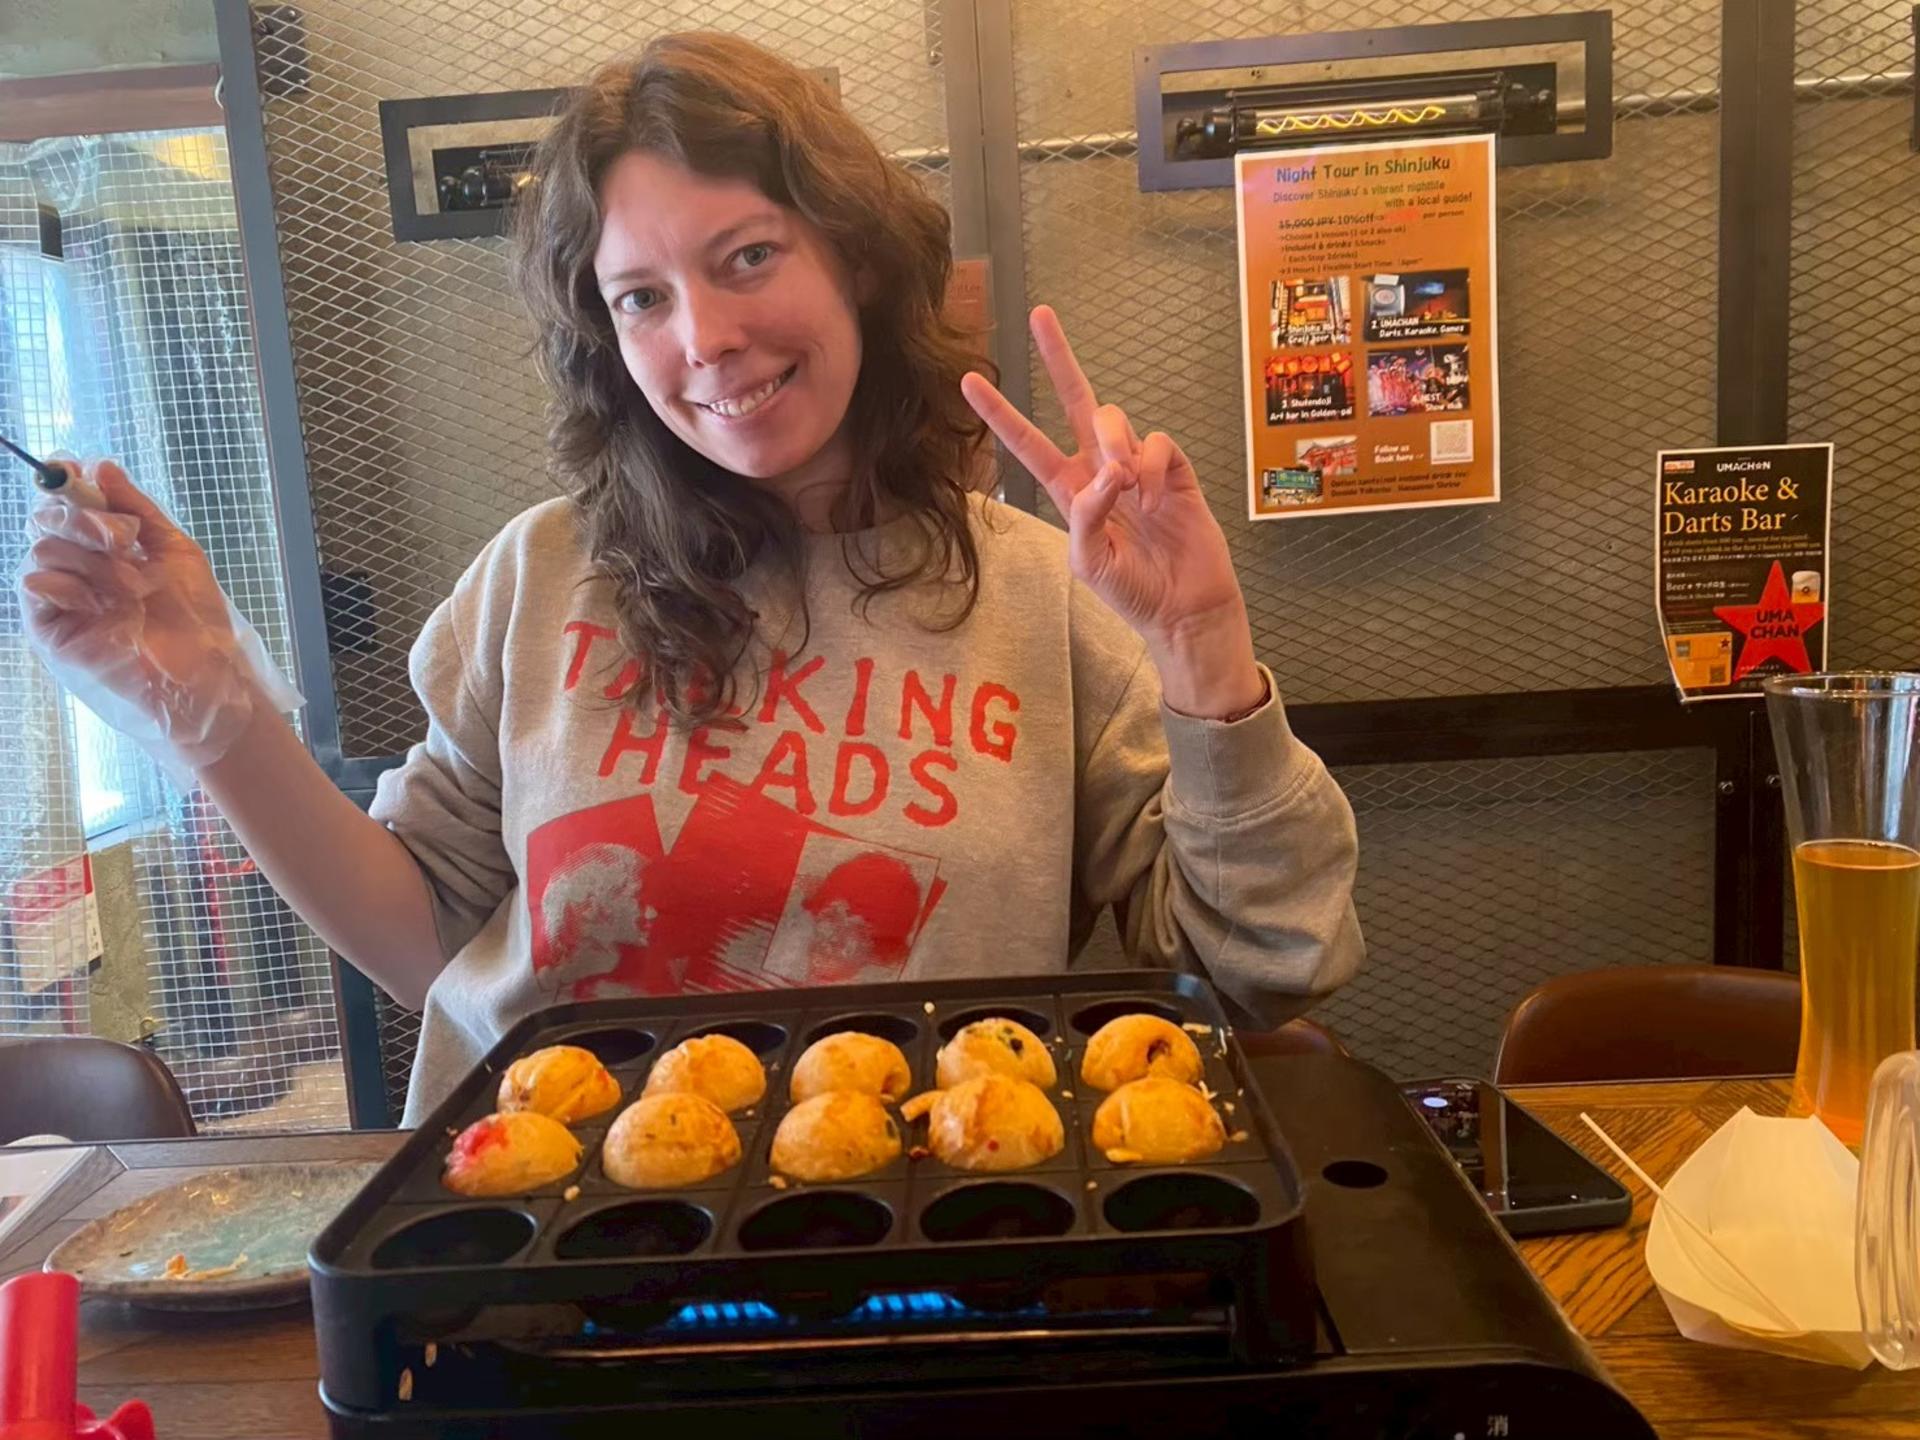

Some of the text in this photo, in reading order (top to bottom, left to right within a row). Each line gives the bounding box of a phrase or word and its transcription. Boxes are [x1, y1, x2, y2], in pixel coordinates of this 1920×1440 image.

[1276, 165, 1317, 183] Night
[1323, 162, 1359, 179] Tour
[1365, 161, 1379, 176] in
[1273, 191, 1314, 203] Discover
[1371, 182, 1403, 194] vibrant
[1407, 180, 1445, 194] nightlife
[1385, 192, 1473, 208] with a local guide!
[1438, 209, 1464, 217] person
[1664, 476, 1800, 506] Karaoke &
[1664, 507, 1787, 535] Darts Bar
[1756, 609, 1795, 624] UMA
[1751, 625, 1800, 640] CHAN
[597, 708, 958, 828] HEADS
